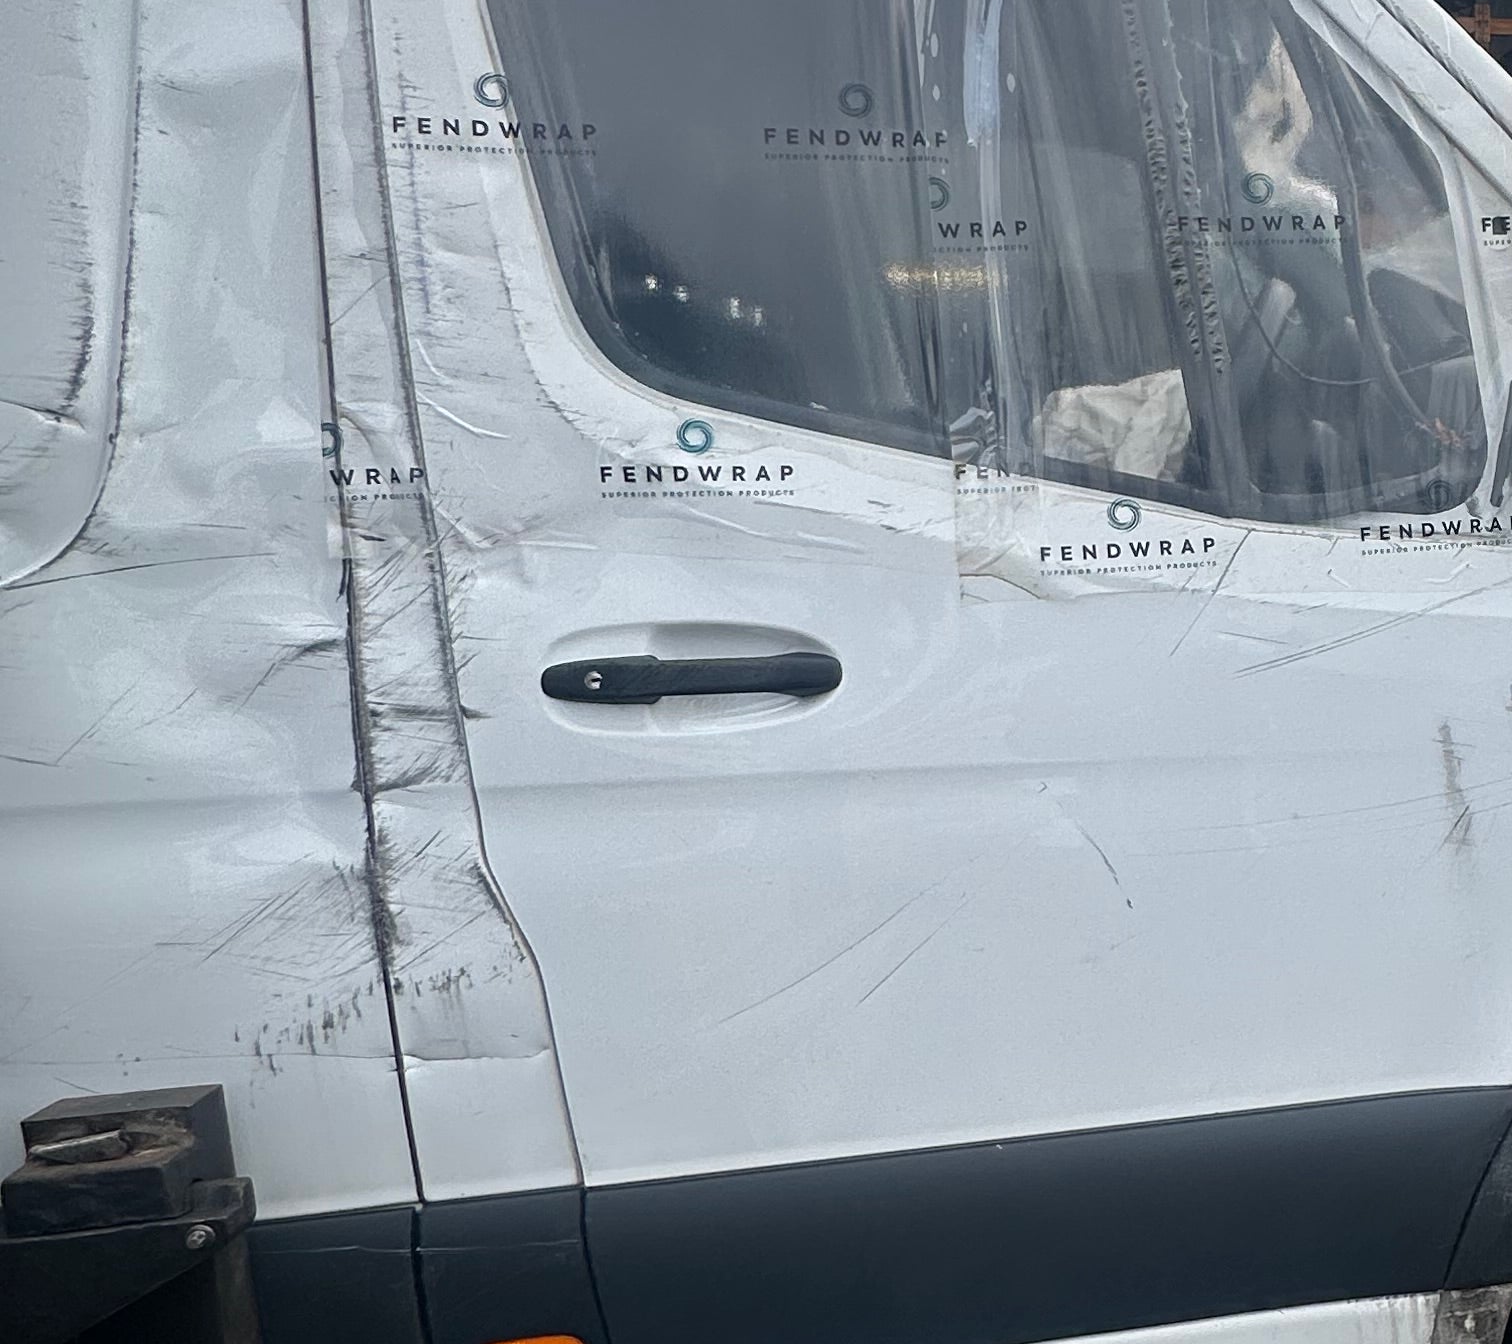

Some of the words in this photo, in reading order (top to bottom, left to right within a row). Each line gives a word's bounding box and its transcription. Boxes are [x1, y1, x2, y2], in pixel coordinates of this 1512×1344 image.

[392, 117, 597, 141] FENDWRAP
[937, 221, 1027, 238] WRAP
[1178, 215, 1346, 233] FENDWRAP
[329, 467, 424, 485] WRAP
[600, 465, 794, 483] FENDWRAP
[1040, 538, 1216, 562] FENDWRAP
